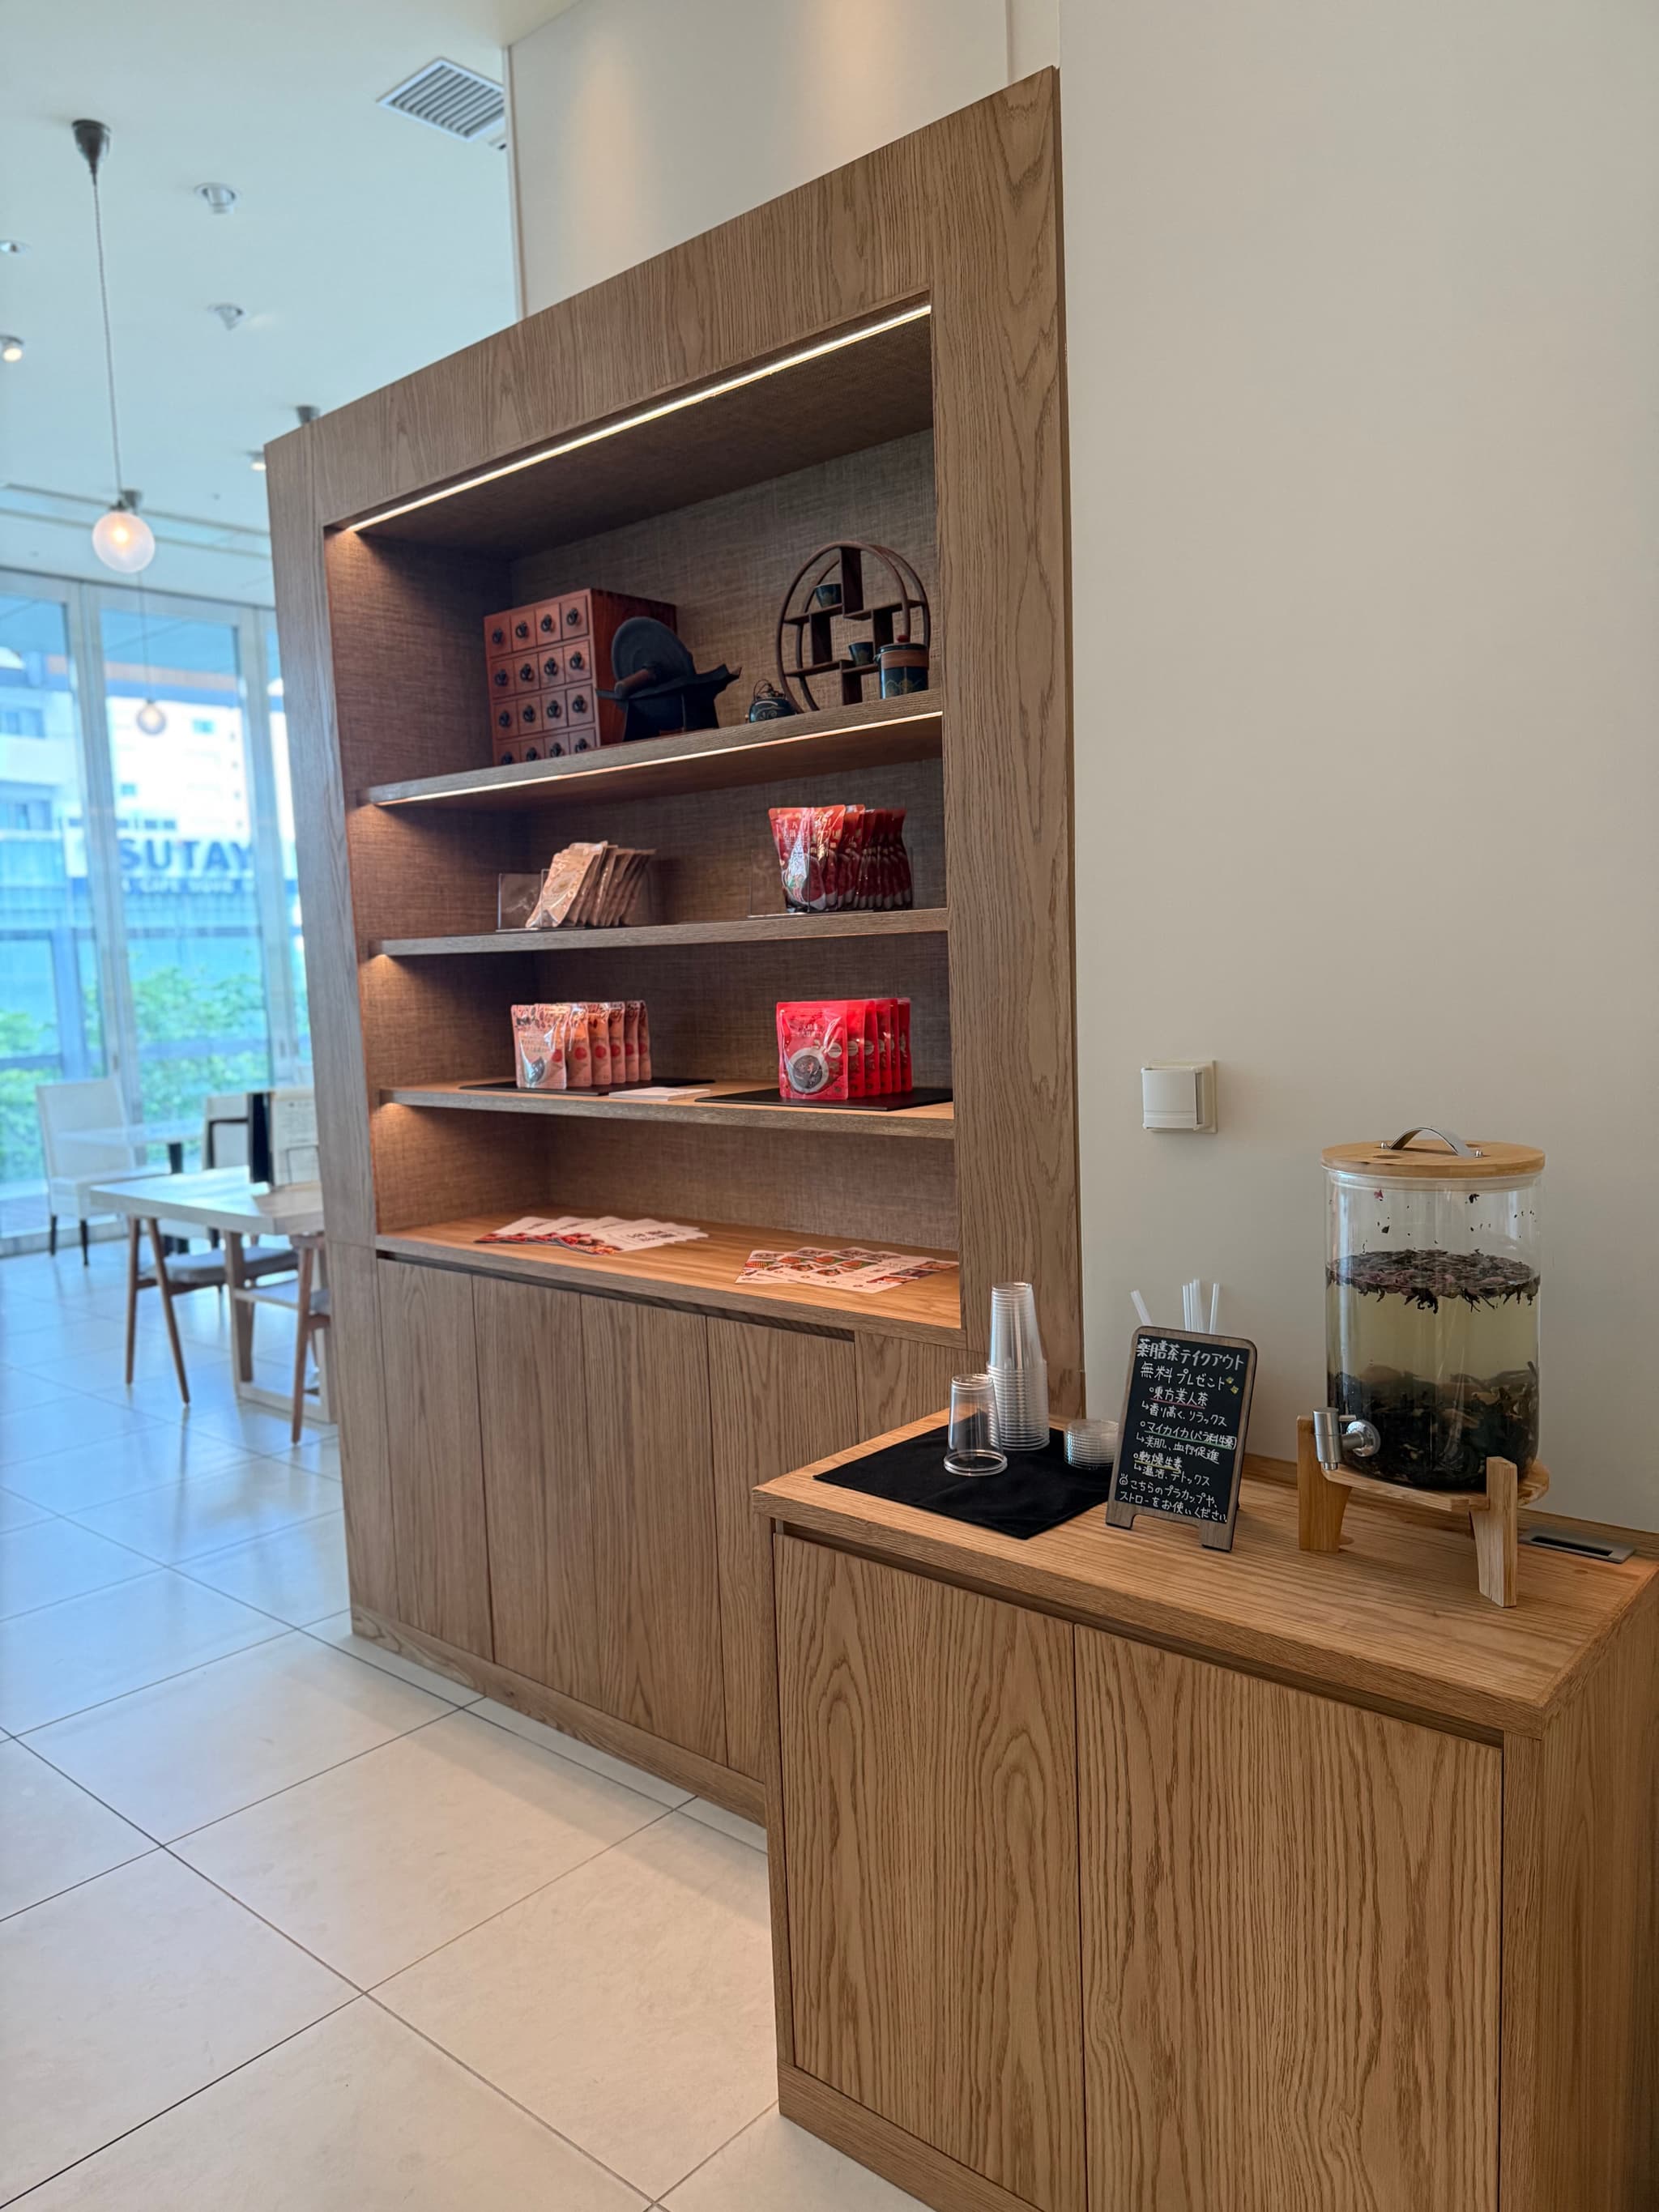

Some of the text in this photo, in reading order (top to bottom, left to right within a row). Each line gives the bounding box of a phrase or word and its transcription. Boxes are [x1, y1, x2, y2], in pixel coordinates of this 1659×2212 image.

[1136, 1338, 1244, 1370] 薬膳茶テイクアウト
